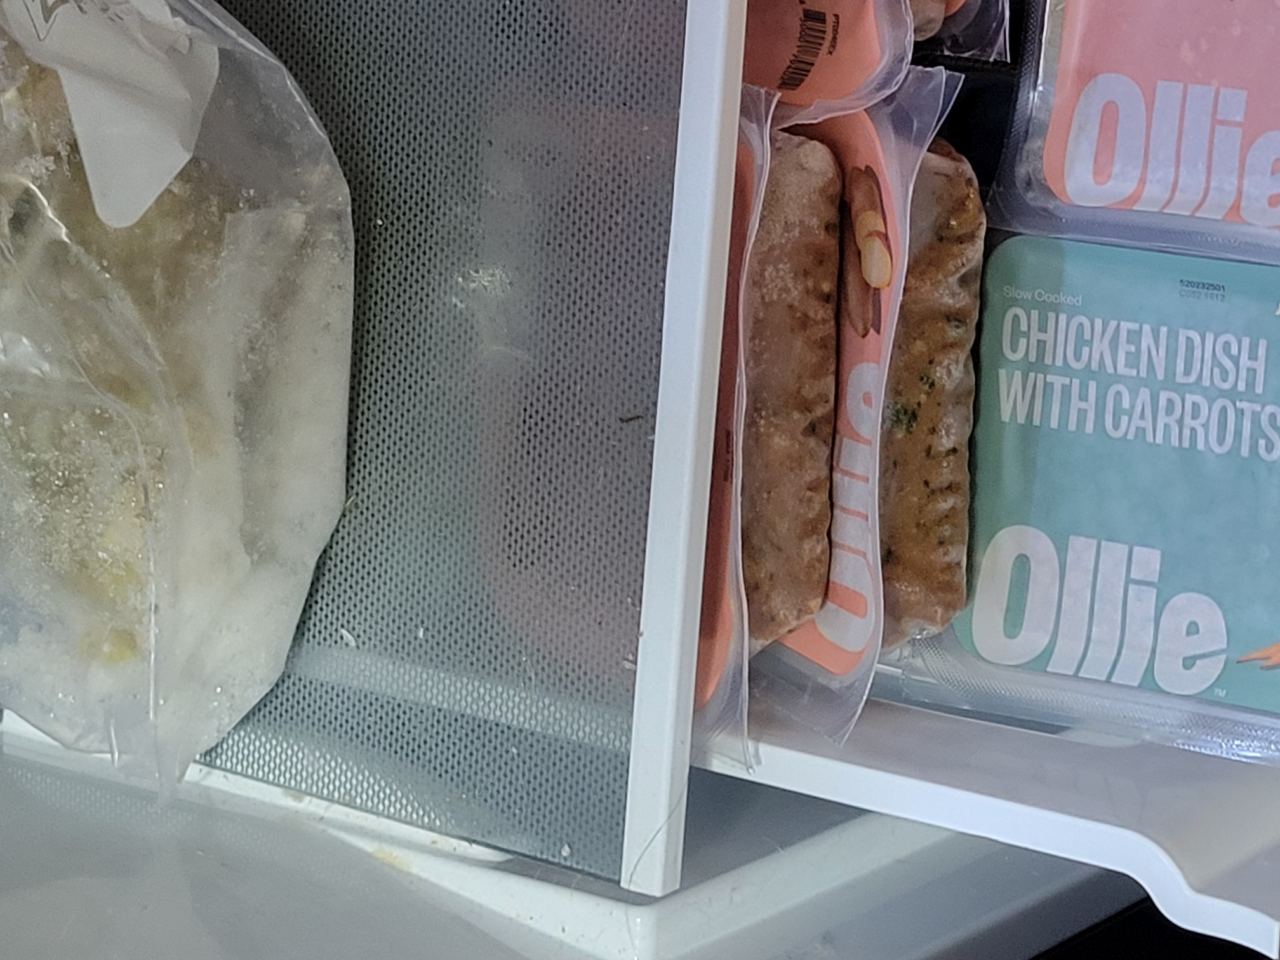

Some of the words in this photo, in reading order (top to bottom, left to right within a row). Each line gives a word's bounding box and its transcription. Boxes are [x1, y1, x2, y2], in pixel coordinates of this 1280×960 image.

[1003, 285, 1033, 300] Slow
[1034, 289, 1082, 306] Cooked
[1001, 306, 1167, 381] CHICKEN
[1175, 329, 1268, 395] DISH
[998, 368, 1096, 435] WITH
[972, 524, 1228, 696] Ollie
